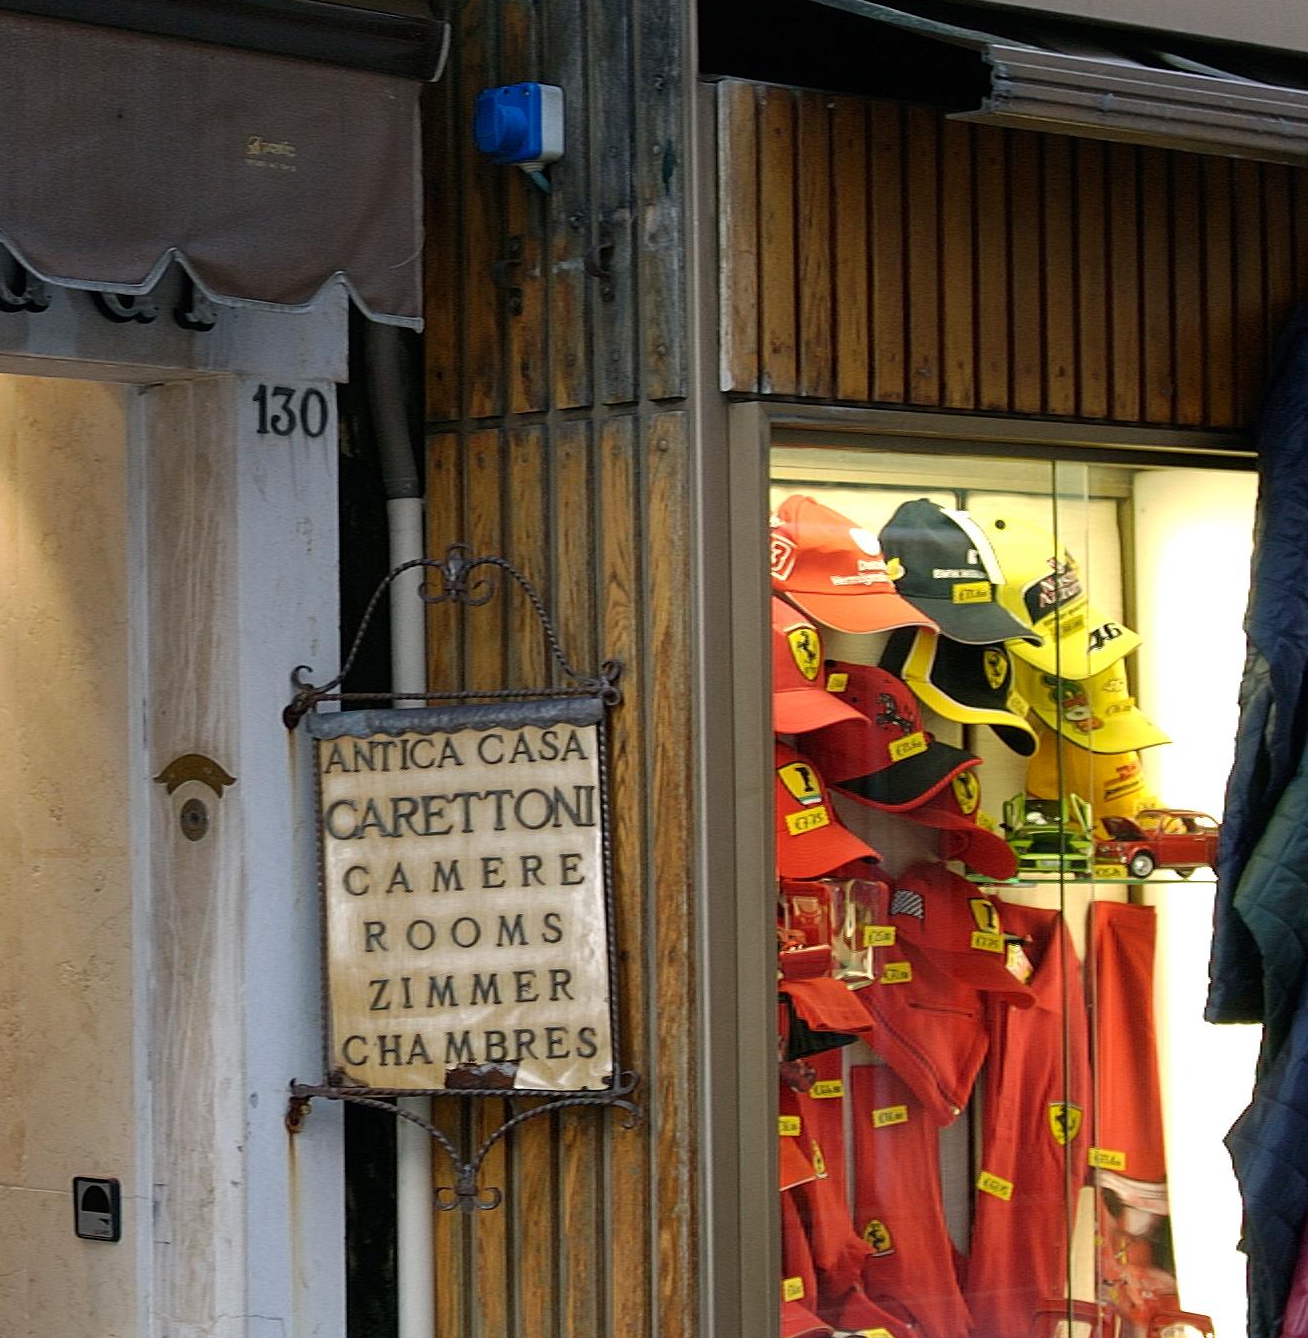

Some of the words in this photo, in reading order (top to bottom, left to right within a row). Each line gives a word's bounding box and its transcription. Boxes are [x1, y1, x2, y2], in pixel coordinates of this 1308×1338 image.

[252, 384, 328, 438] 130
[323, 736, 463, 774] ANTICA
[477, 729, 588, 765] CASA
[325, 785, 596, 841] CARETTONI
[342, 853, 586, 897] CAMERE
[364, 913, 564, 953] ROOMS
[368, 968, 575, 1012] ZIMMER
[342, 1027, 598, 1067] CHAMBRES
